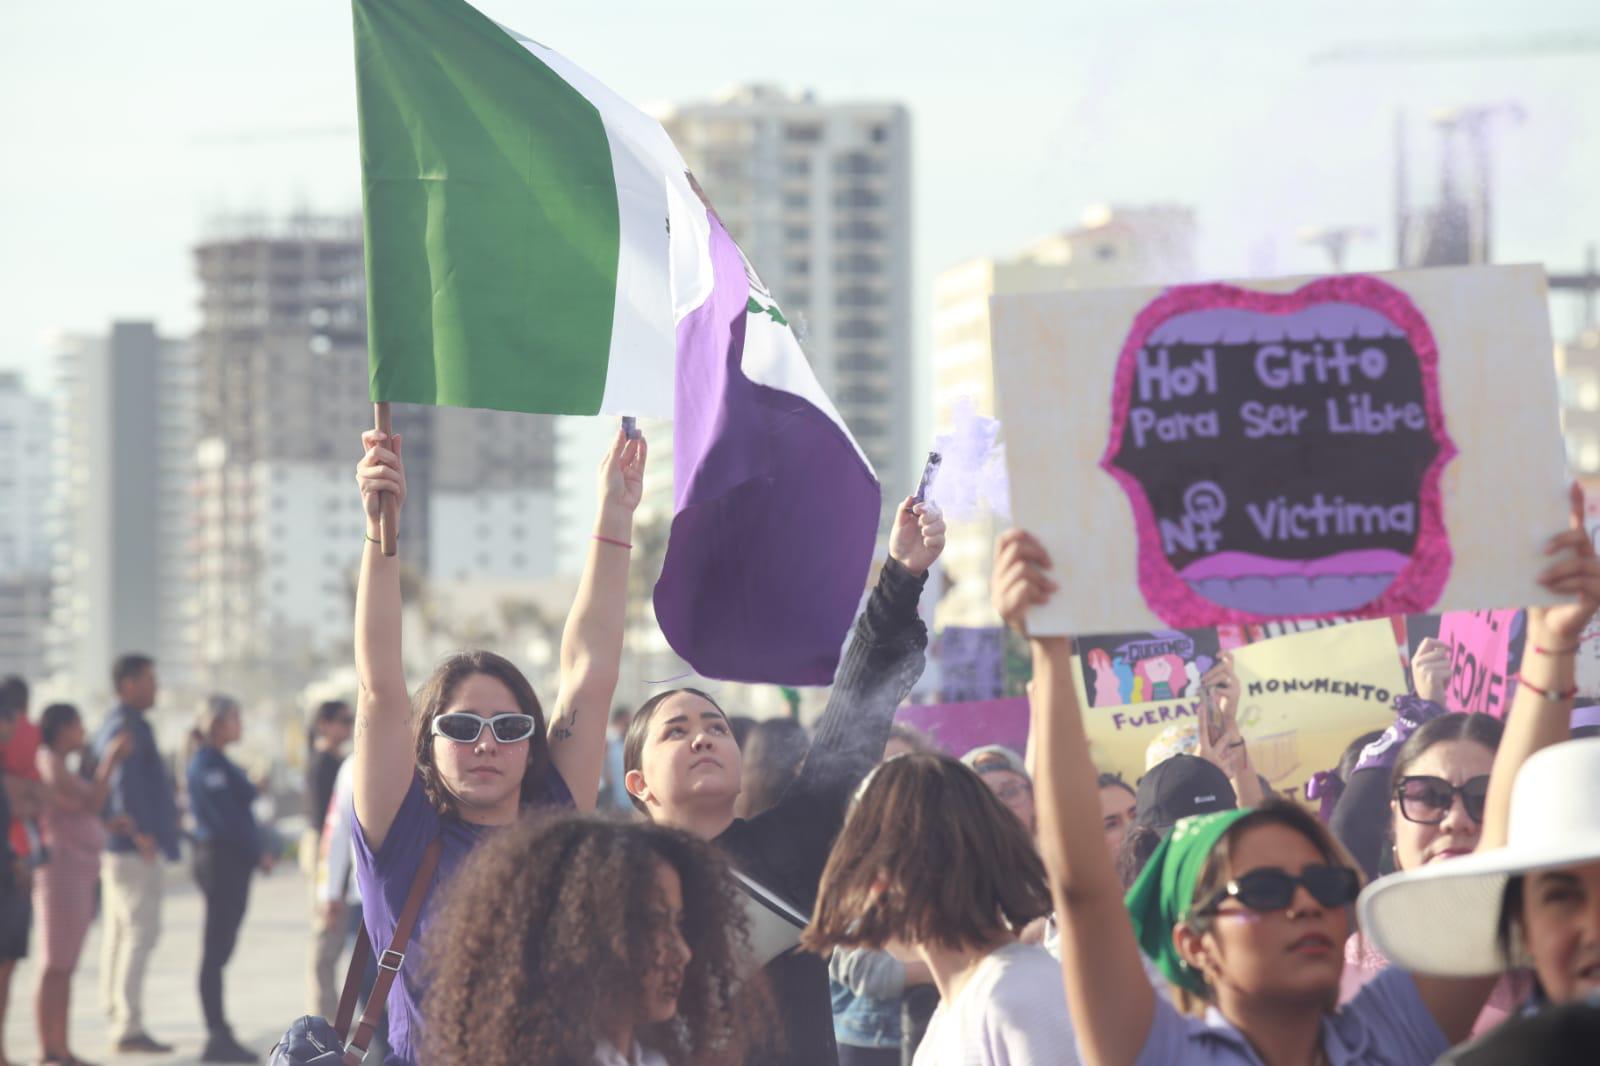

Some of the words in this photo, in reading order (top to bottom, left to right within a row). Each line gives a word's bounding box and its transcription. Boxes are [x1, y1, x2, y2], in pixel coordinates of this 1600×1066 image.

[1254, 342, 1388, 389] Grito
[1130, 407, 1219, 448] Para
[1240, 401, 1308, 438] Ser
[1327, 394, 1425, 434] Libre
[1246, 494, 1416, 541] Victima
